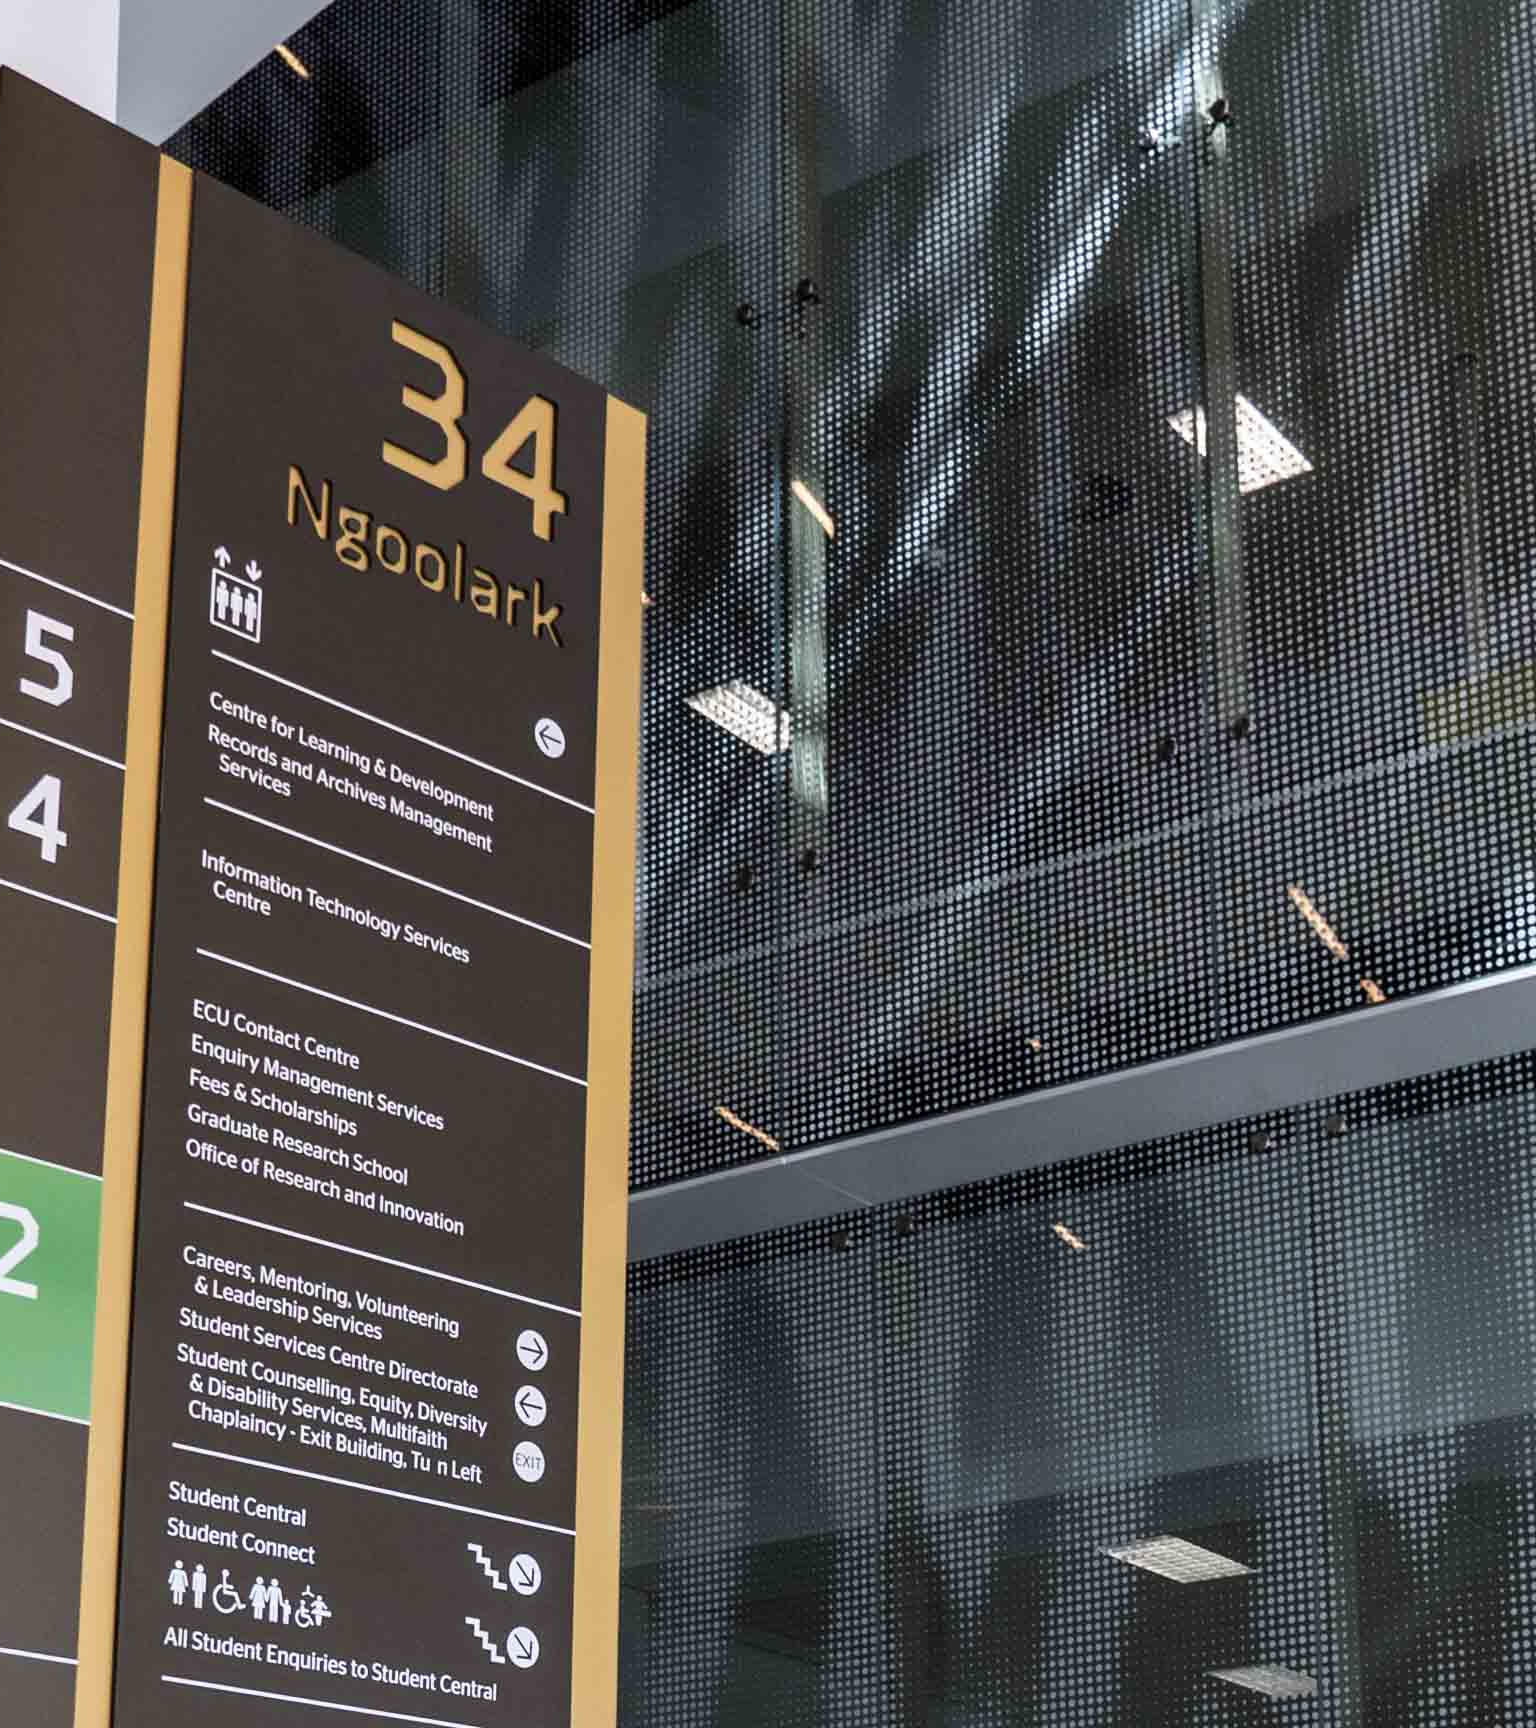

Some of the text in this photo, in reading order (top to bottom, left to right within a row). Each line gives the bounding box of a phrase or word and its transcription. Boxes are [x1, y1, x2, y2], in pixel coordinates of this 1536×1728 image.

[382, 319, 566, 542] 34
[287, 464, 562, 647] Ngoolark
[19, 608, 75, 707] 5
[208, 723, 493, 853] Records and Archives Management
[209, 691, 494, 822] Centre for Learning & Development
[218, 753, 291, 797] Services
[8, 775, 67, 863] 4
[201, 848, 470, 964] Information Technology Services
[212, 879, 272, 916] Centre
[193, 998, 360, 1070] ECU Contact Centre
[189, 1067, 358, 1137] Fees & Scholarships
[191, 1032, 445, 1131] Enquiry Management Services
[185, 1138, 465, 1236] Office of Research and Innovation
[187, 1103, 408, 1186] Graduate Research School
[183, 1245, 460, 1339] Careers, Mentoring, Volunteering
[194, 1275, 383, 1341] & Leadership Services
[176, 1342, 489, 1438] Student Counselling, Equity, Diversity
[179, 1306, 479, 1399] Student Services Centre Directorate
[188, 1372, 448, 1451] & Disability Services, Multifaith
[188, 1399, 287, 1442] Chaplaincy
[299, 1424, 333, 1450] Exit
[335, 1432, 408, 1469] Building,
[451, 1459, 483, 1485] Left
[168, 1480, 307, 1528] Student Central
[515, 1452, 542, 1471] EXIT
[166, 1516, 316, 1565] Student Connect
[163, 1626, 498, 1702] All Student Enquiries to Student Central
